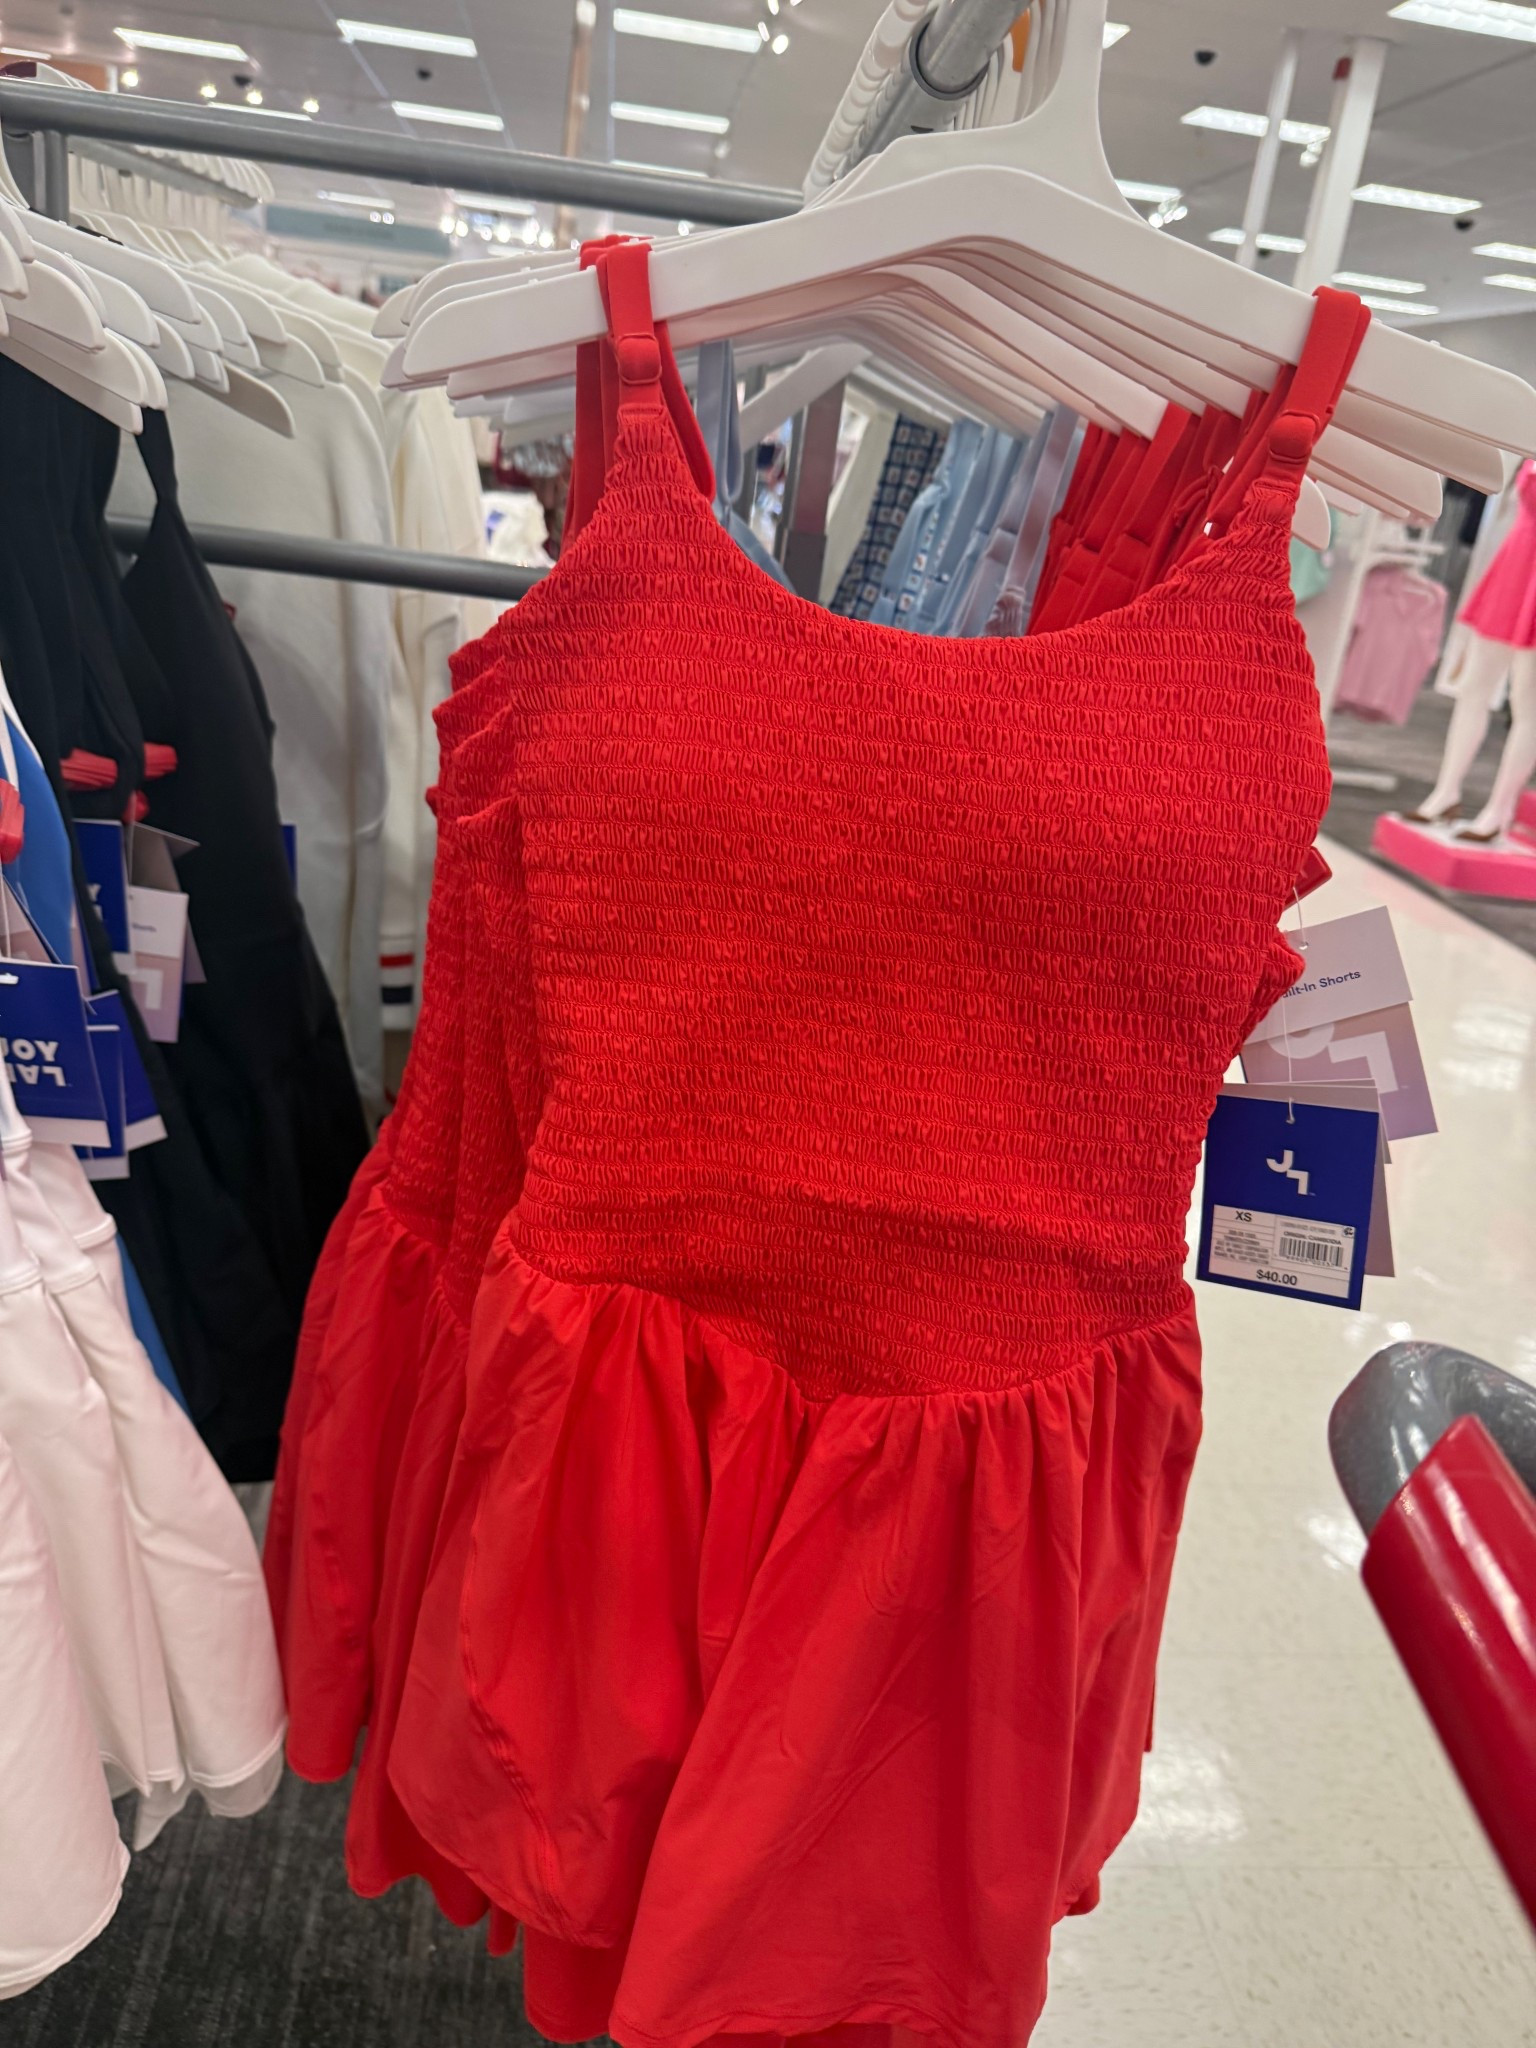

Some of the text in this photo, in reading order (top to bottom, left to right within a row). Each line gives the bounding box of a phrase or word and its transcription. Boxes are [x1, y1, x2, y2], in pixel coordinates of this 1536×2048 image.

[1318, 971, 1361, 989] Shorts
[1235, 1210, 1252, 1222] XS
[1256, 1269, 1298, 1286] $40.00
